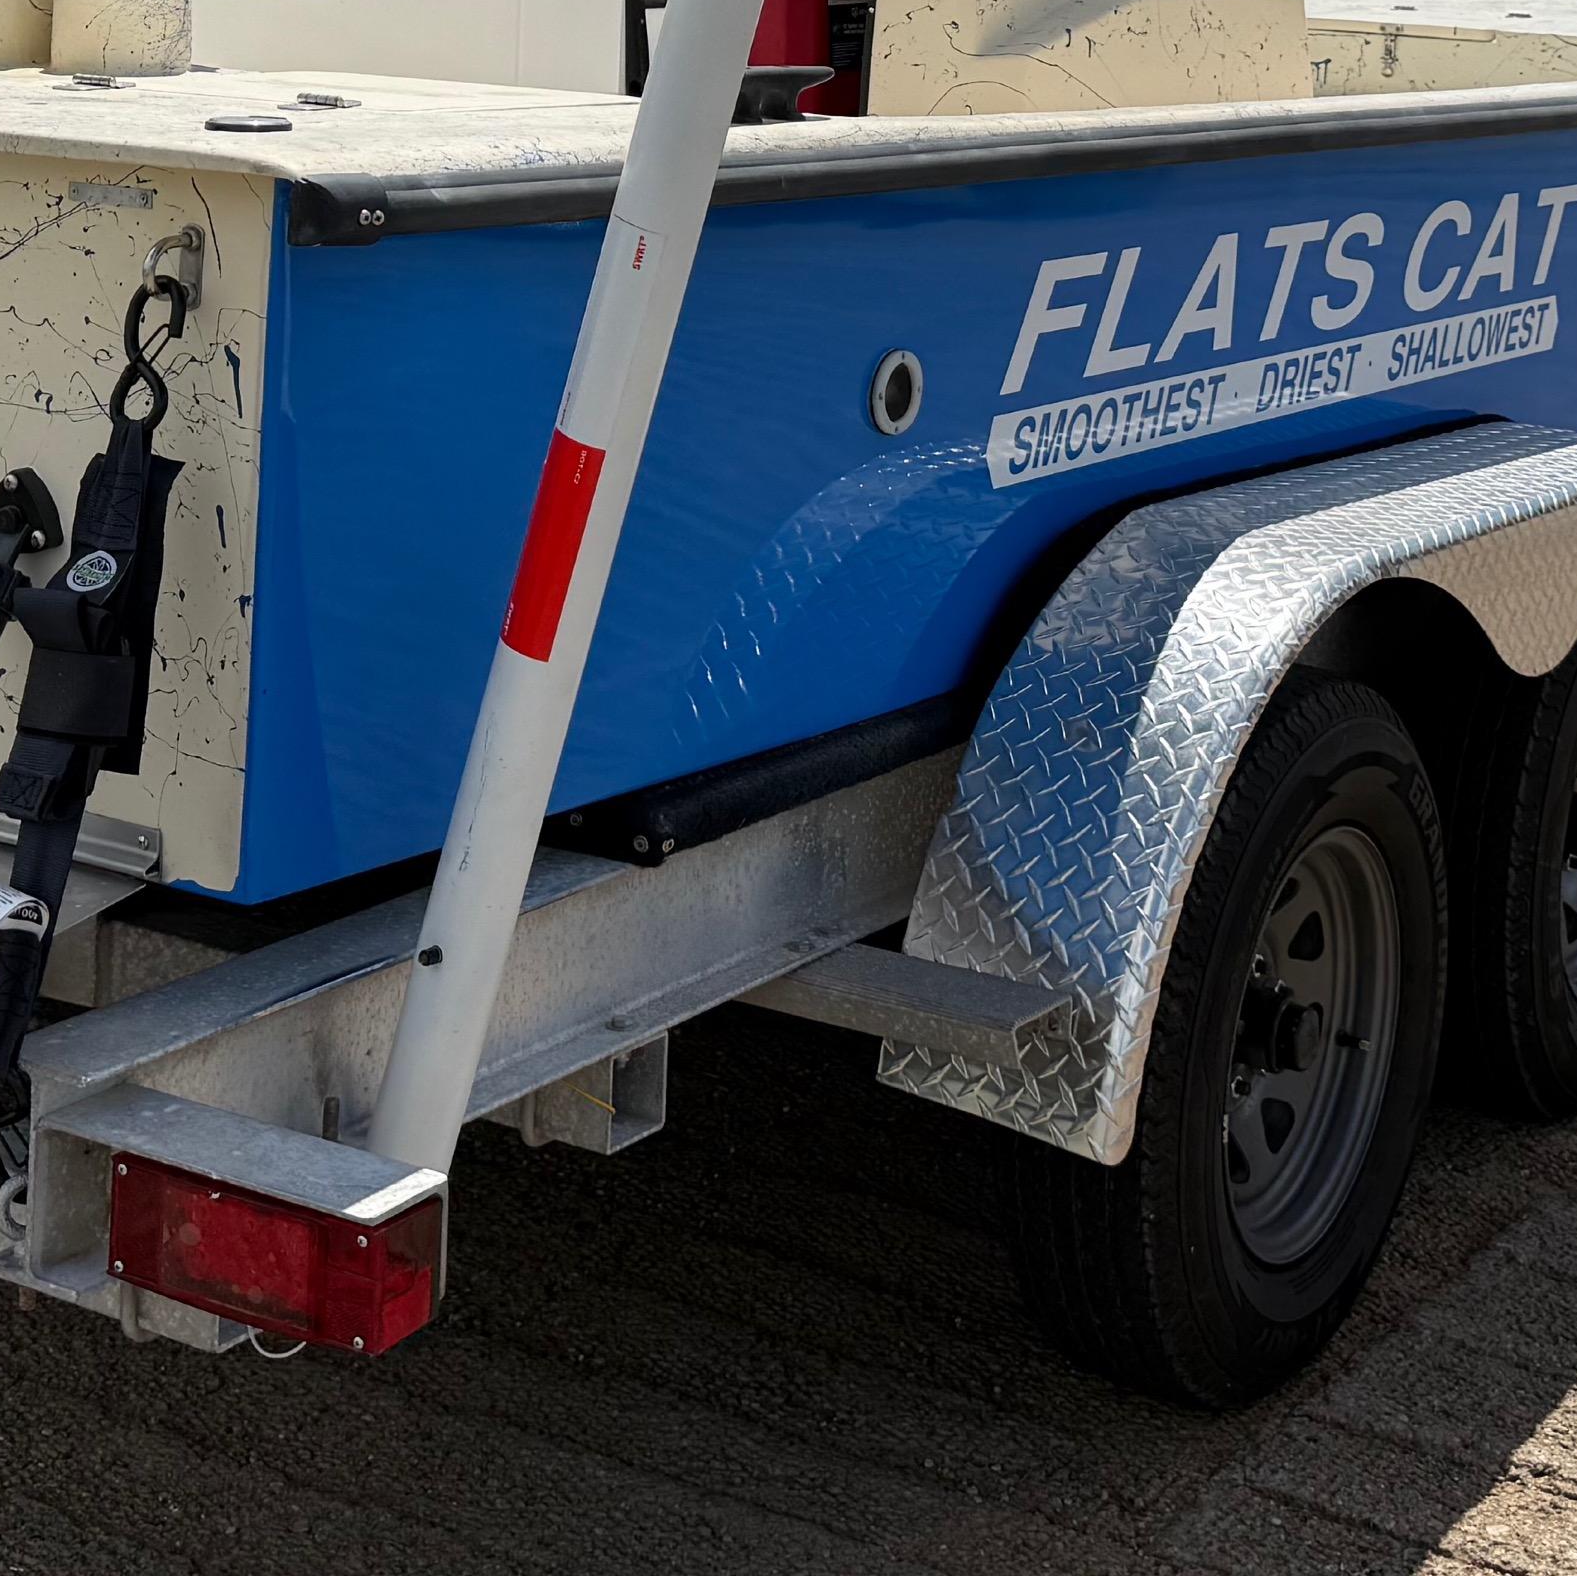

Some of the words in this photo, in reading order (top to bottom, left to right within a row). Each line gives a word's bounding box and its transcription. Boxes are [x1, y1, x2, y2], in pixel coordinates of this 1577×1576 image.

[998, 212, 1385, 396] FLATS
[1007, 372, 1227, 476] SMOOTHEST
[1254, 343, 1363, 414] DRIEST
[1386, 302, 1551, 382] SHALLOWEST
